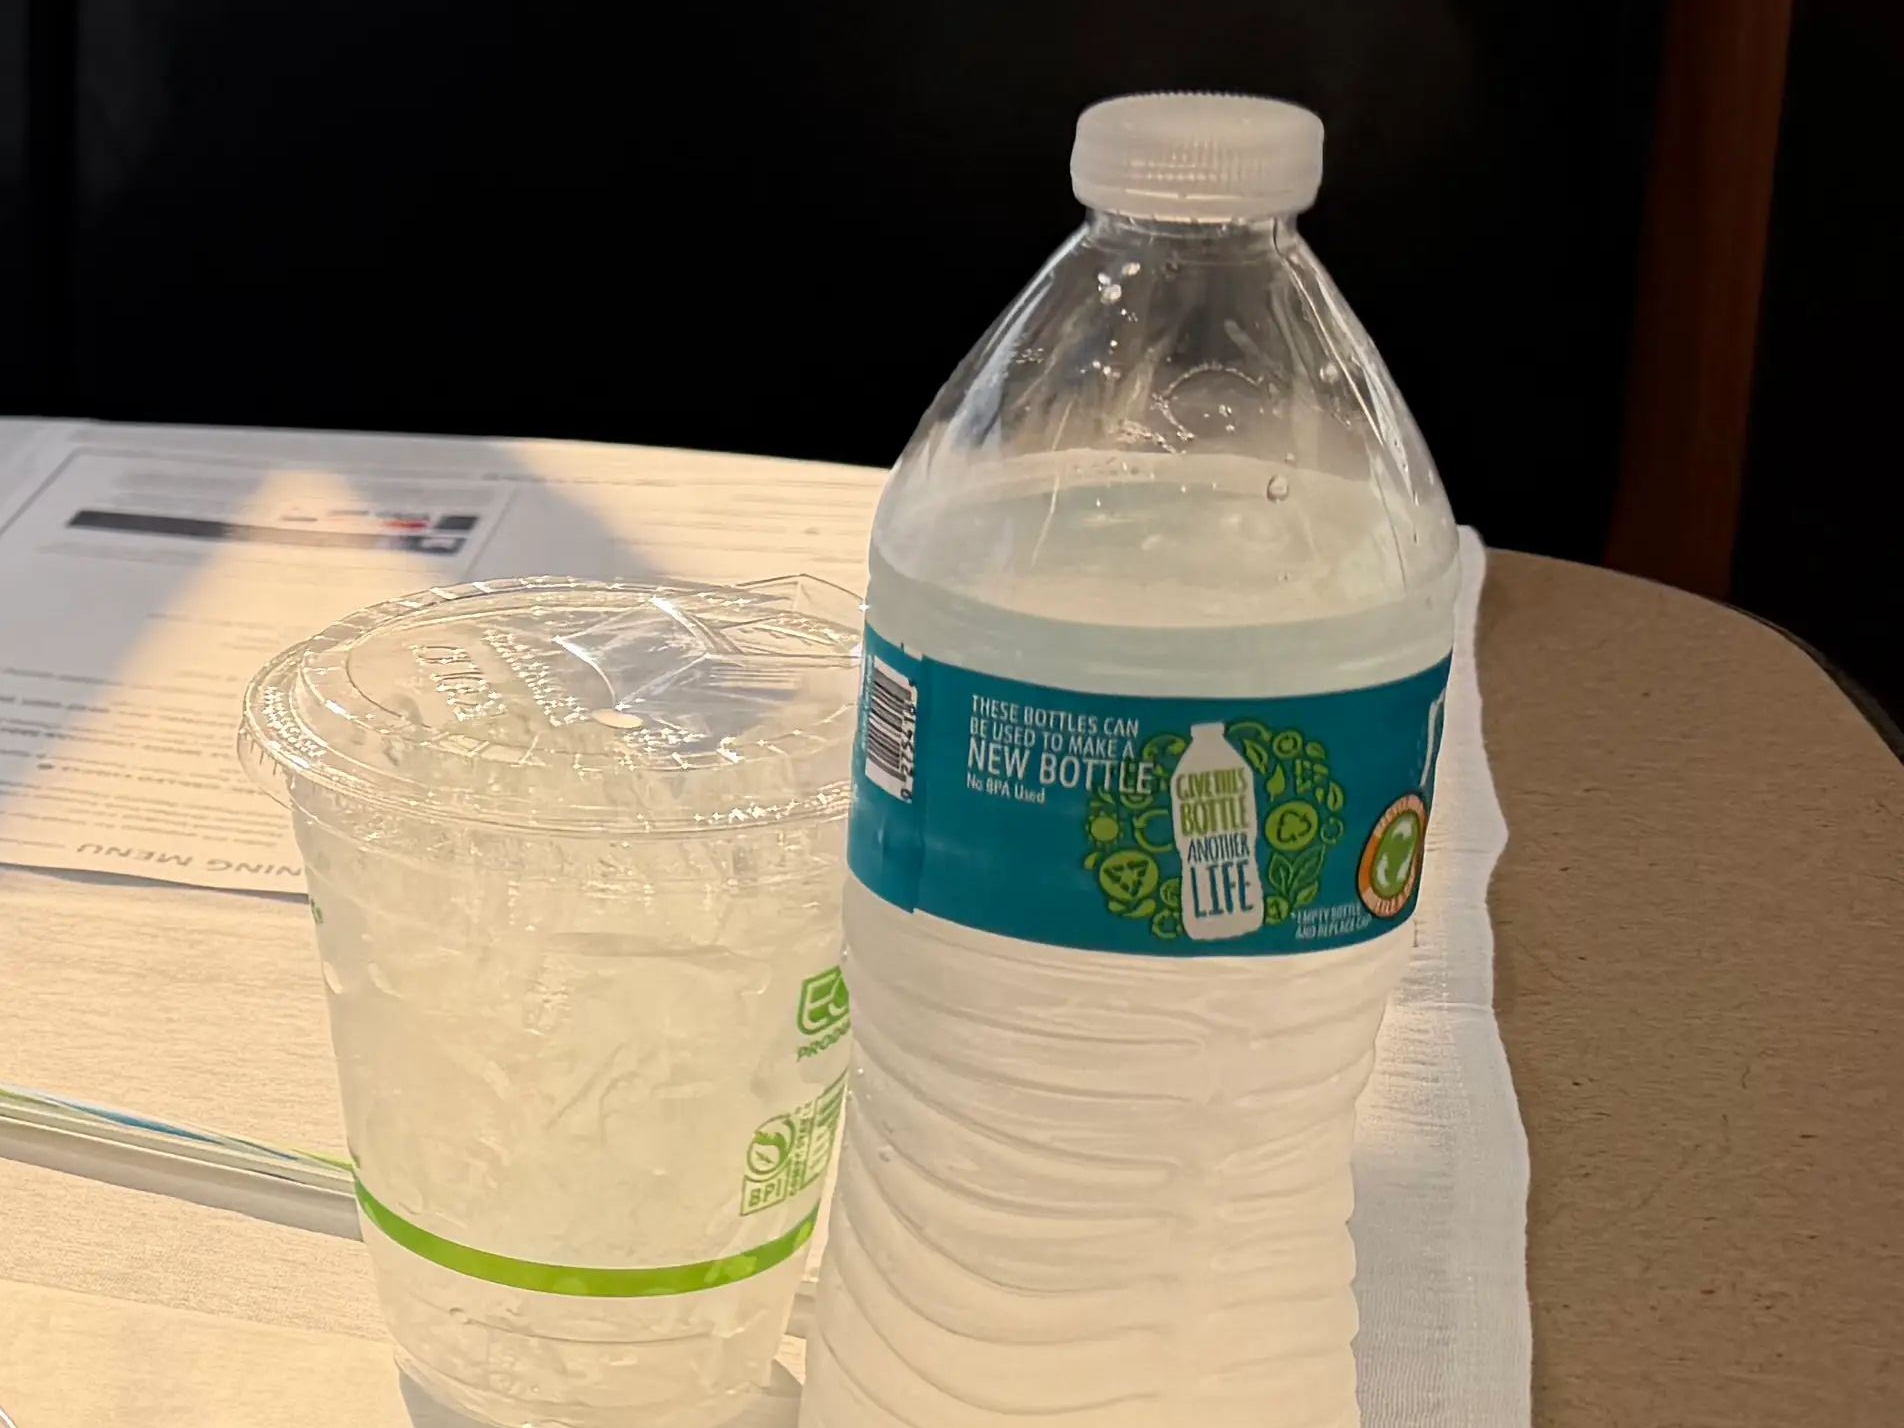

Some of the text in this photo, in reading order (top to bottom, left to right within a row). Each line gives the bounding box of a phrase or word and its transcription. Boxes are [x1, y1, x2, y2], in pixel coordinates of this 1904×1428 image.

[972, 693, 1139, 739] THESE BOTTLES CAN
[969, 716, 1135, 759] BE USED TO MAKE A
[967, 736, 1154, 795] NEW BOTTLE
[1176, 767, 1249, 801] GIVE THIS
[966, 773, 1046, 804] No BPA Used
[1180, 794, 1250, 838] BOTTLE
[76, 842, 193, 868] MENU
[1187, 831, 1250, 864] ANOTHER
[1190, 859, 1255, 919] LIFE
[749, 1178, 782, 1208] BPI
